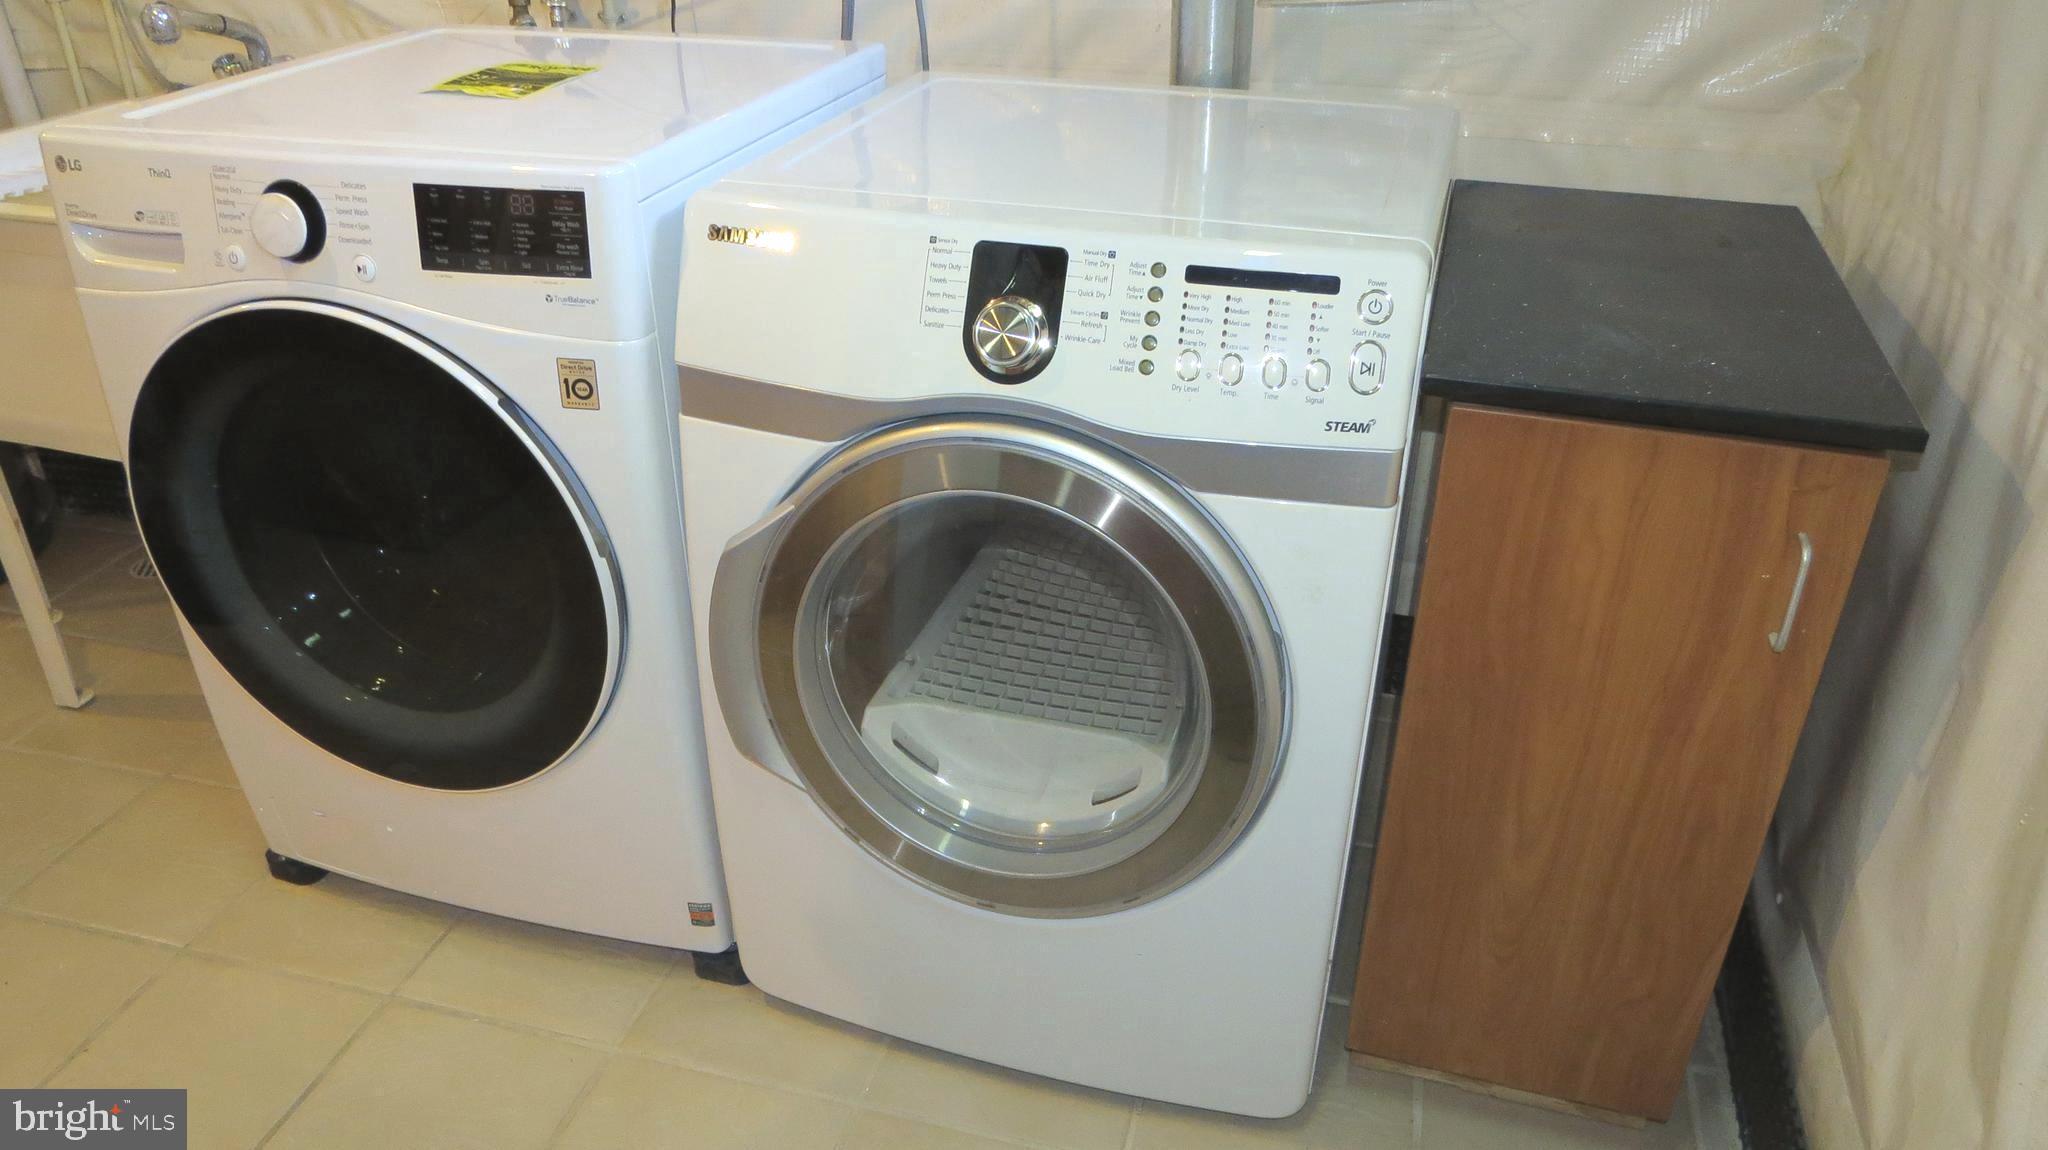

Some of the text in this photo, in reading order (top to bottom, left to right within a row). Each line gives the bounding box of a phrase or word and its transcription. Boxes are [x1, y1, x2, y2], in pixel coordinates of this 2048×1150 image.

[67, 158, 82, 171] LG
[148, 168, 171, 178] ThinQ
[341, 181, 367, 190] Delicates
[354, 209, 370, 217] Wash
[932, 247, 952, 255] Normal
[930, 262, 962, 272] Heavy Duty
[1085, 259, 1110, 269] Time Dry
[1129, 262, 1147, 271] Adjust
[1368, 279, 1387, 287] Power
[1126, 285, 1144, 294] Adjust
[942, 291, 957, 299] Press
[1078, 289, 1106, 300] Quick Dry
[925, 305, 950, 314] Delicates
[1120, 309, 1141, 317] Wrinkle
[1081, 320, 1102, 328] Refresh
[1196, 328, 1204, 336] Dry
[1352, 328, 1367, 337] Start
[1372, 330, 1391, 339] Pause
[1123, 341, 1137, 349] Cycle
[563, 378, 594, 401] 10
[1171, 384, 1200, 393] Dry Level
[1305, 395, 1325, 404] Signal
[1324, 421, 1371, 433] STEAM
